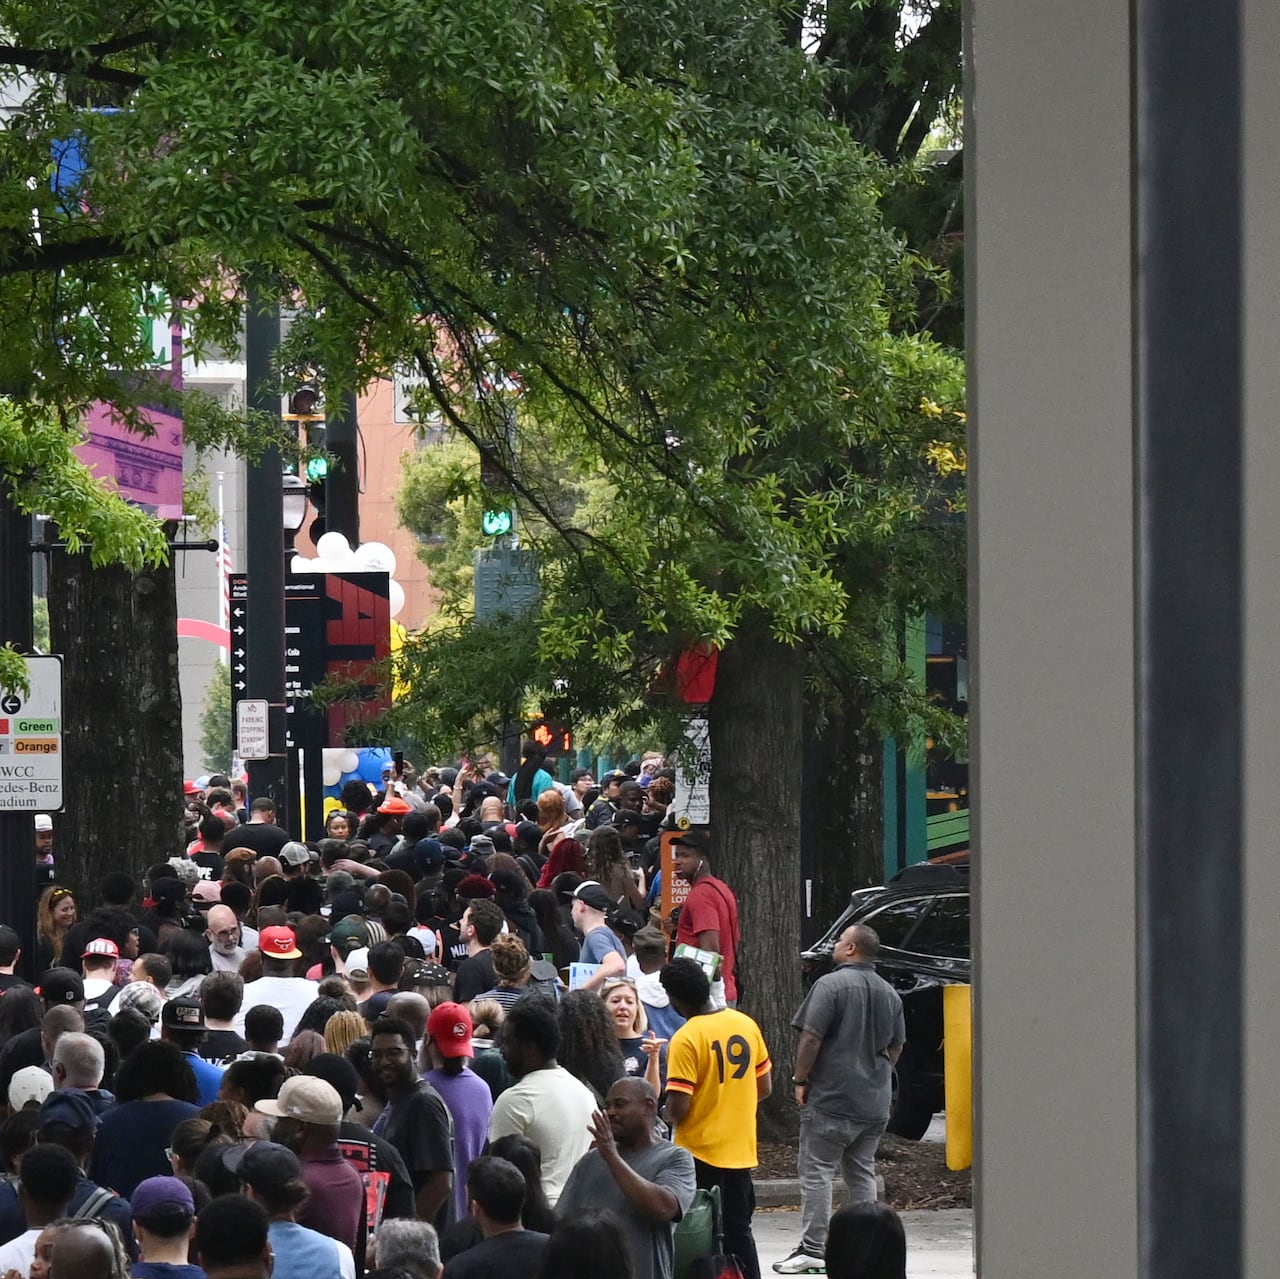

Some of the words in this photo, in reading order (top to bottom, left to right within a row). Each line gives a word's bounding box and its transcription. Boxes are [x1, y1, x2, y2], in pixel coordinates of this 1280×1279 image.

[19, 722, 53, 732] Green
[241, 726, 265, 734] STOPPING
[16, 741, 57, 753] Orange
[711, 1034, 751, 1084] 19
